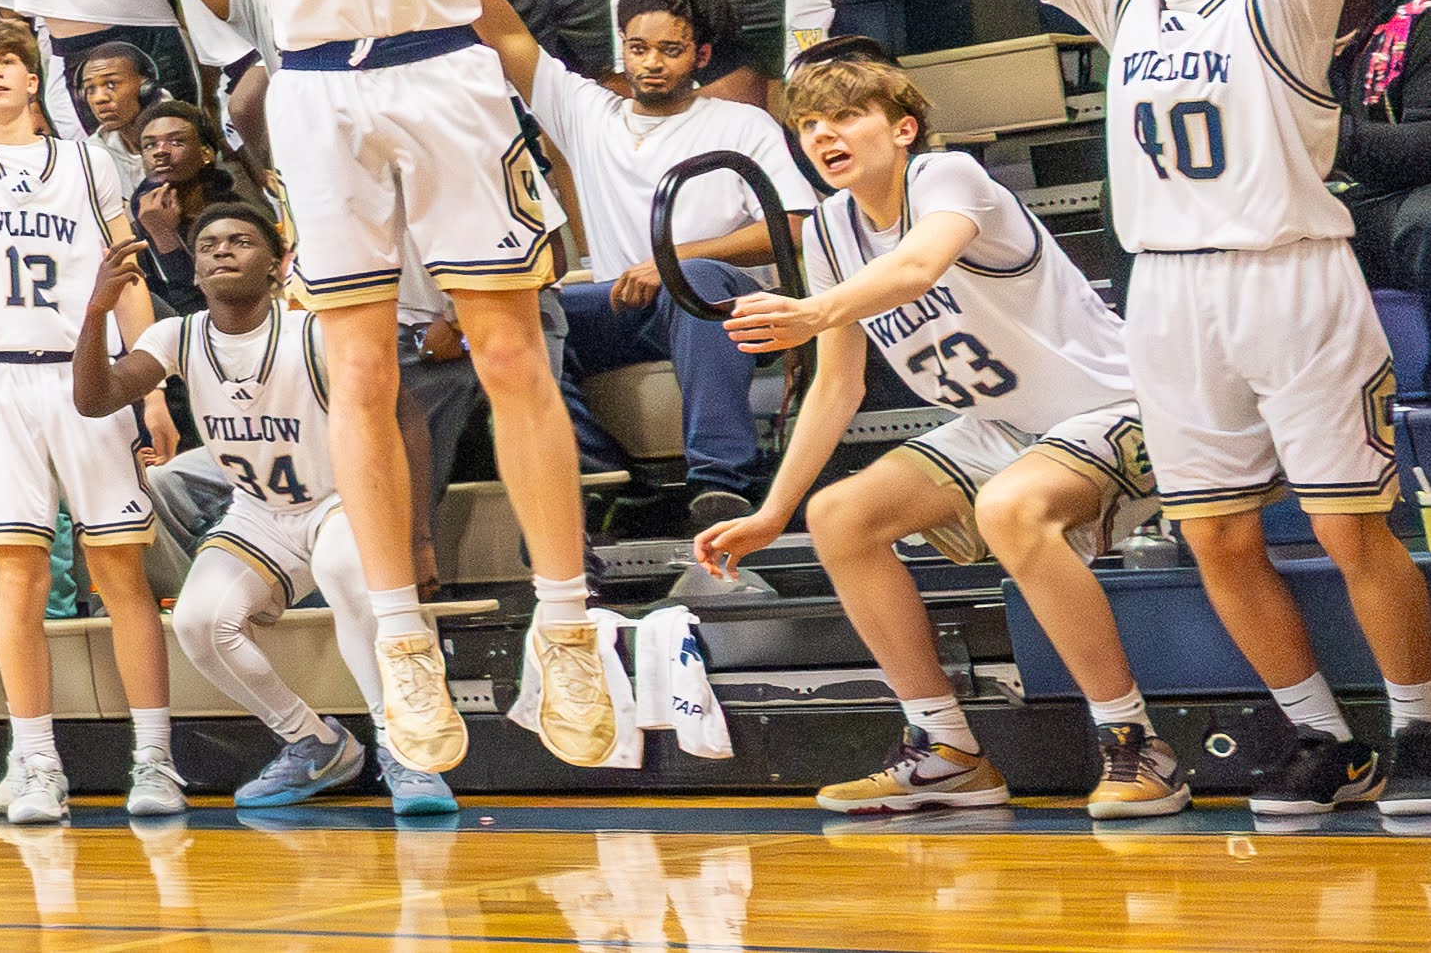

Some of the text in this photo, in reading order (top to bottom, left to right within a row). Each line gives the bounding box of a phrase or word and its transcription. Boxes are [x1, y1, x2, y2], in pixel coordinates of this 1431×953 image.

[1134, 100, 1226, 179] 40
[5, 245, 61, 314] 12
[907, 331, 1018, 408] 33
[203, 415, 300, 444] WILLOW
[219, 453, 313, 505] 34
